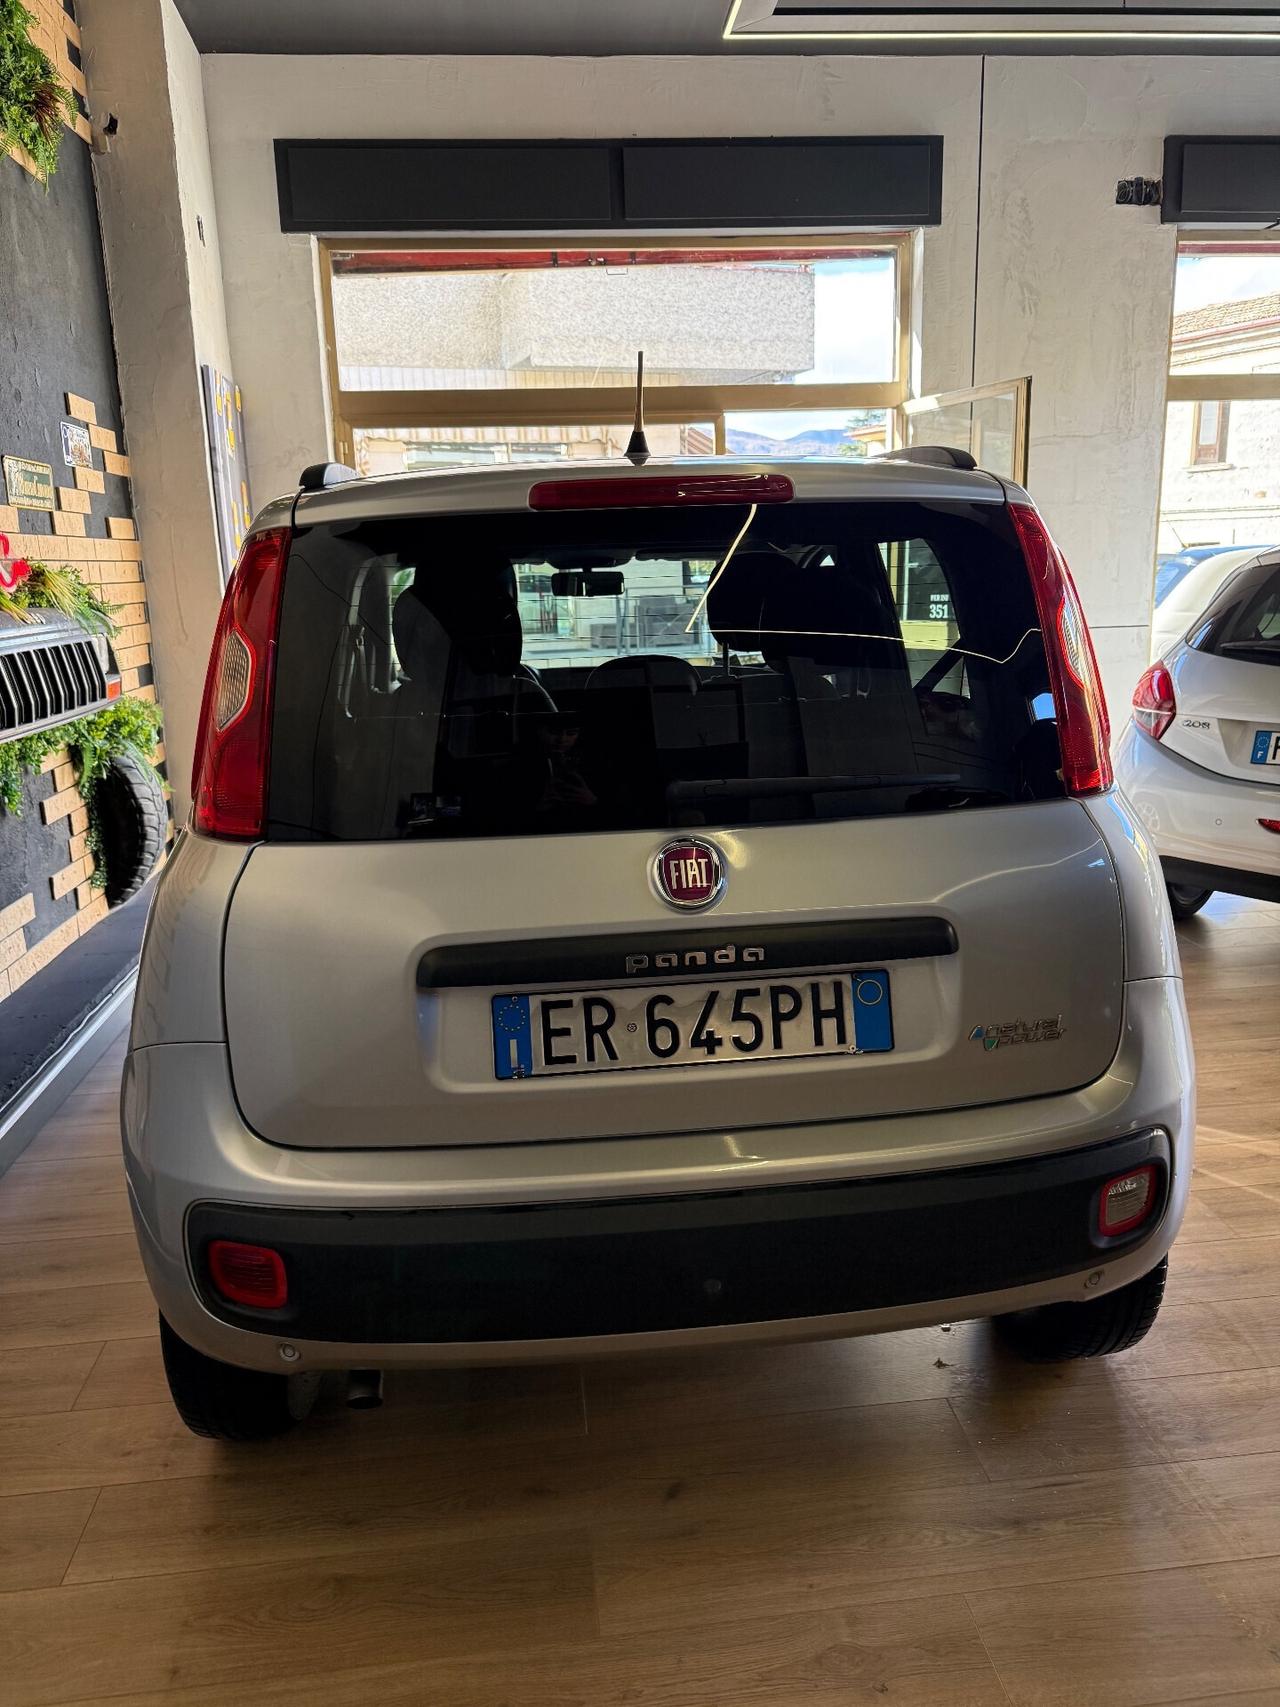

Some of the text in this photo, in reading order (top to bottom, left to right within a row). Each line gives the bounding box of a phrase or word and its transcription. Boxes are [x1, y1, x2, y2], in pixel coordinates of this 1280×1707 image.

[929, 604, 949, 618] 351
[1183, 720, 1210, 729] 208
[1257, 751, 1264, 759] F
[669, 858, 708, 889] FIAT
[625, 943, 765, 974] panda
[541, 981, 847, 1066] ER 645PH
